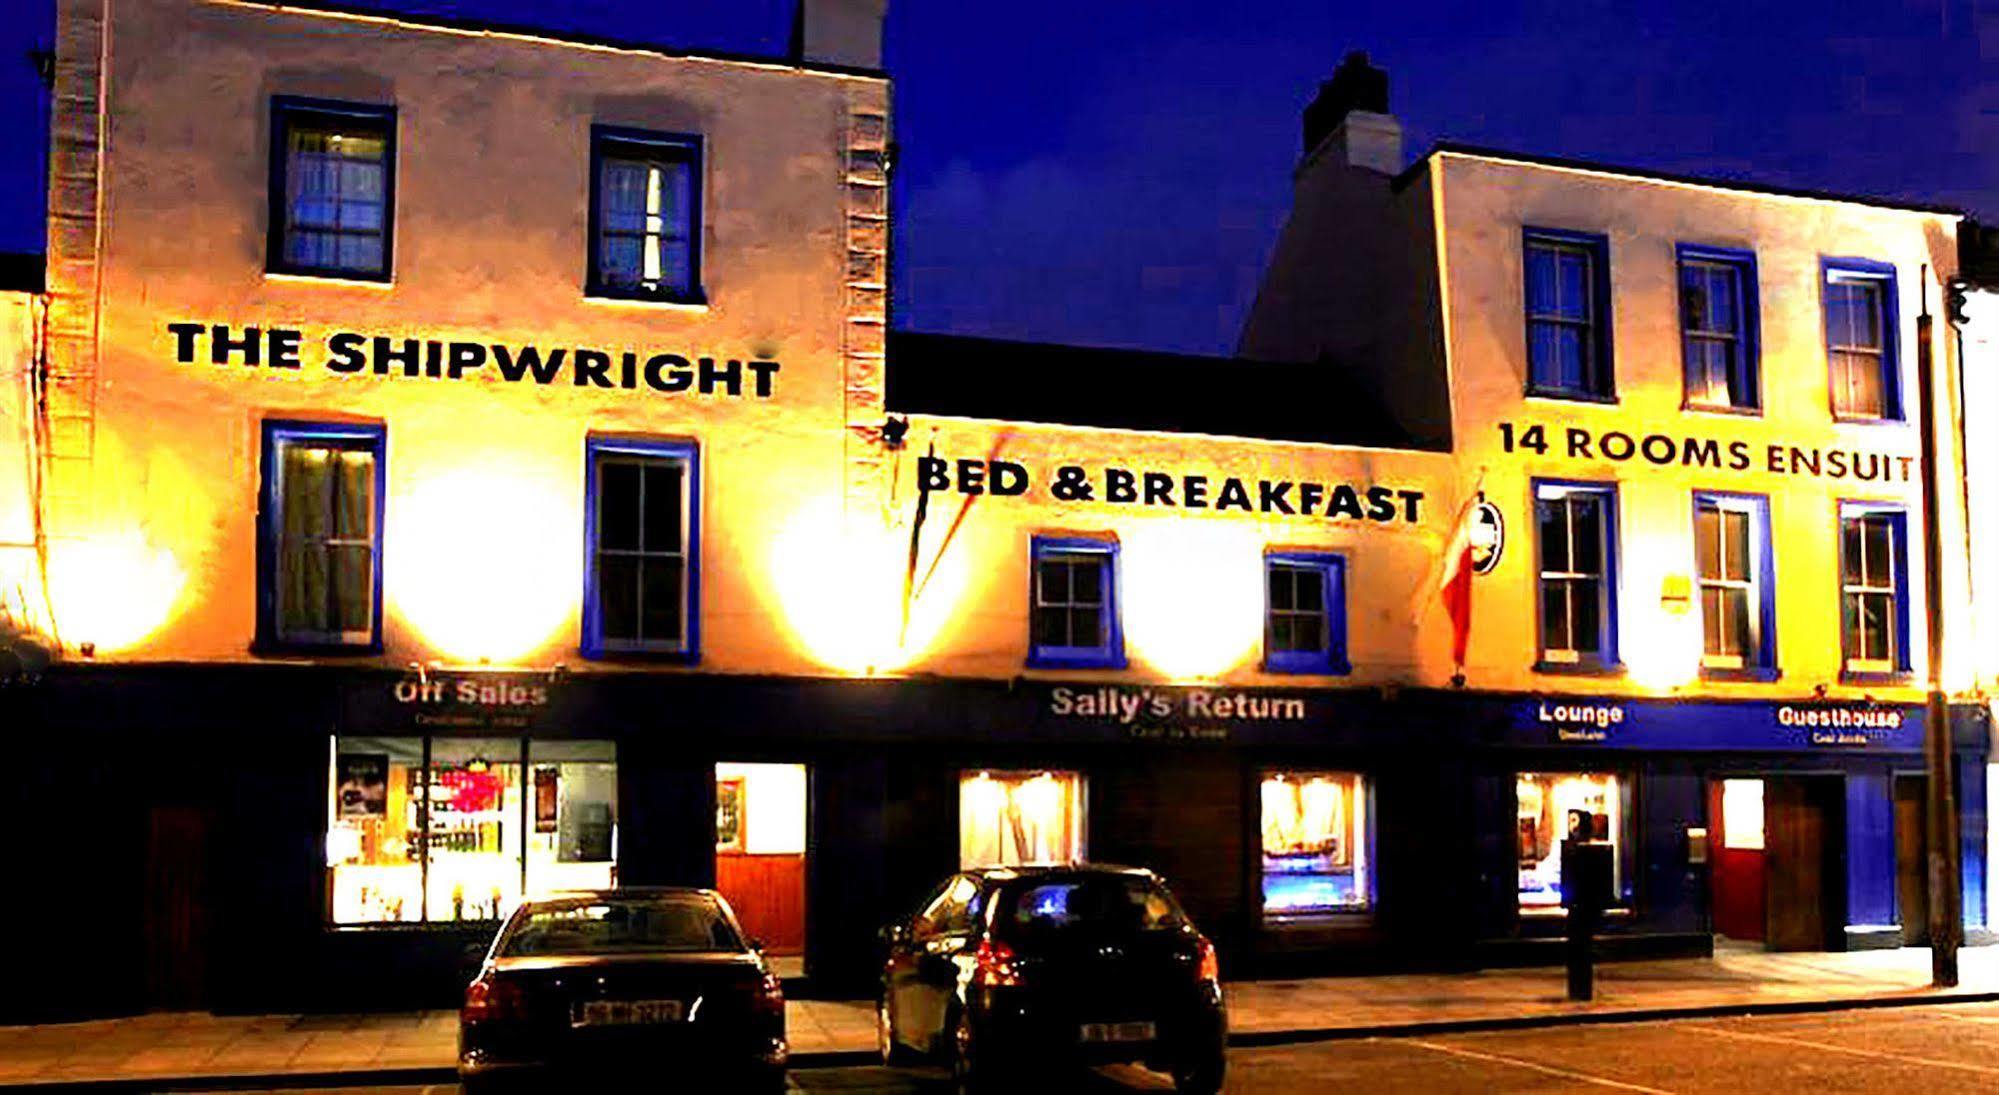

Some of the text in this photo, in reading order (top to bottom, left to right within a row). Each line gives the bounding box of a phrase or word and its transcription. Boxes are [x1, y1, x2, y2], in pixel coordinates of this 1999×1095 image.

[168, 323, 780, 398] THE SHIPWRIGHT
[1498, 423, 1915, 482] 14 ROOMS ENSUIT
[918, 456, 1424, 523] BED & BREAKFAST
[456, 680, 547, 705] Sales
[1051, 687, 1305, 722] Sally's Return
[1539, 704, 1624, 725] Lounge
[1777, 706, 1903, 729] Guesthouse
